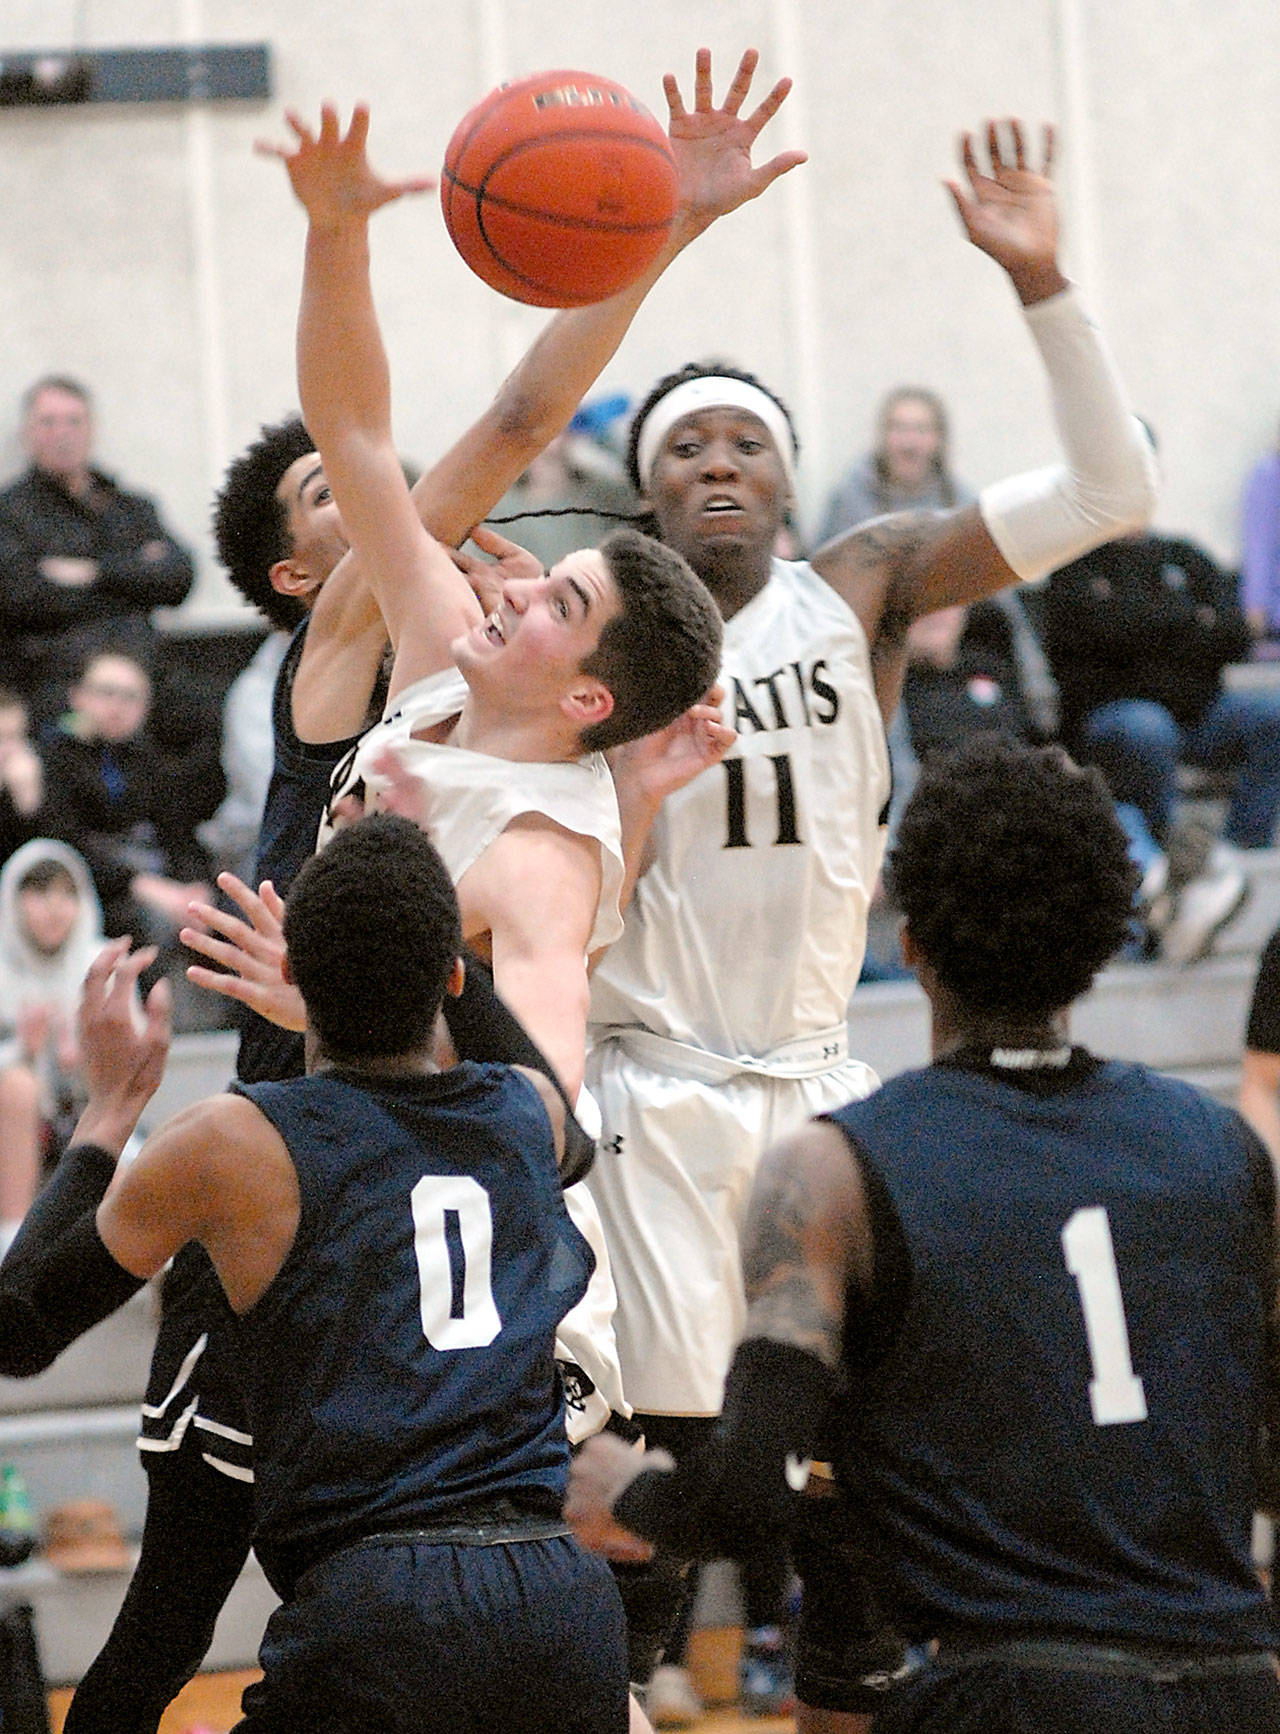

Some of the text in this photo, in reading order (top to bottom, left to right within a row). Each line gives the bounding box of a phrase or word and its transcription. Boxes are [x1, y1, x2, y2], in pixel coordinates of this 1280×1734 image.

[729, 659, 840, 734] ATIS
[721, 753, 803, 848] 11
[410, 1174, 503, 1352] 0
[1061, 1206, 1148, 1425] 1
